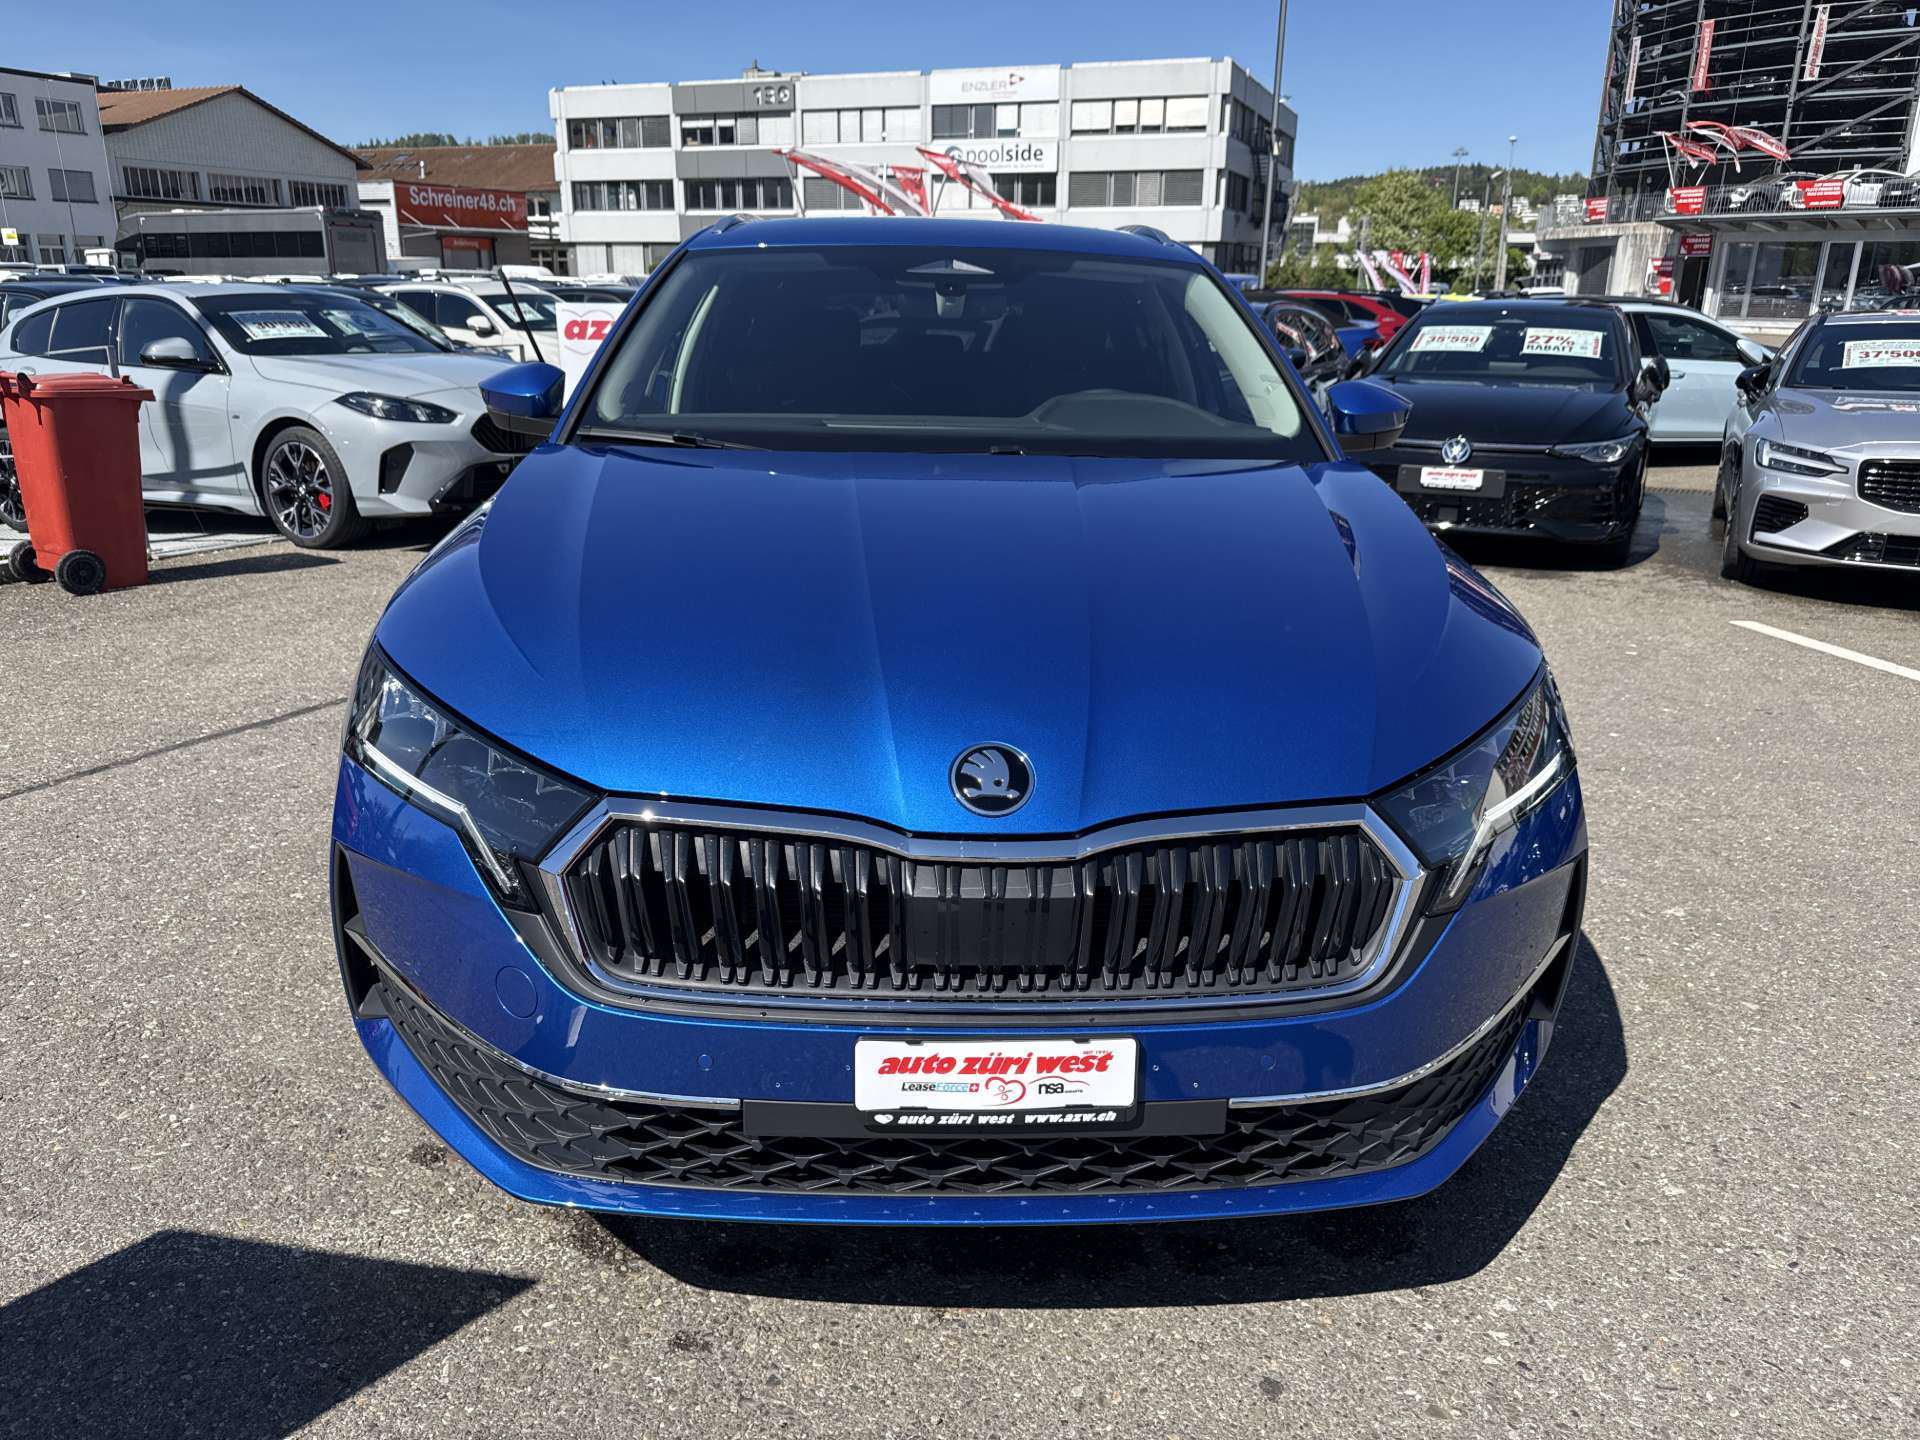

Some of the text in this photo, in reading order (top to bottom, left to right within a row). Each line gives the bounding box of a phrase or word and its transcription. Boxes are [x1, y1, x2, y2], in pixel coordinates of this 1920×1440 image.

[961, 80, 1007, 93] ENZLER
[966, 144, 1043, 164] poolside
[409, 185, 516, 212] Schreiner48.ch
[564, 319, 615, 341] az
[1528, 335, 1575, 347] 27%
[1526, 344, 1574, 353] RABATT
[878, 1052, 1114, 1074] auto züri west
[901, 1082, 969, 1092] LeaseForce
[1039, 1083, 1064, 1095] nsa
[898, 1111, 1117, 1125] auto züri west www.azw.ch
